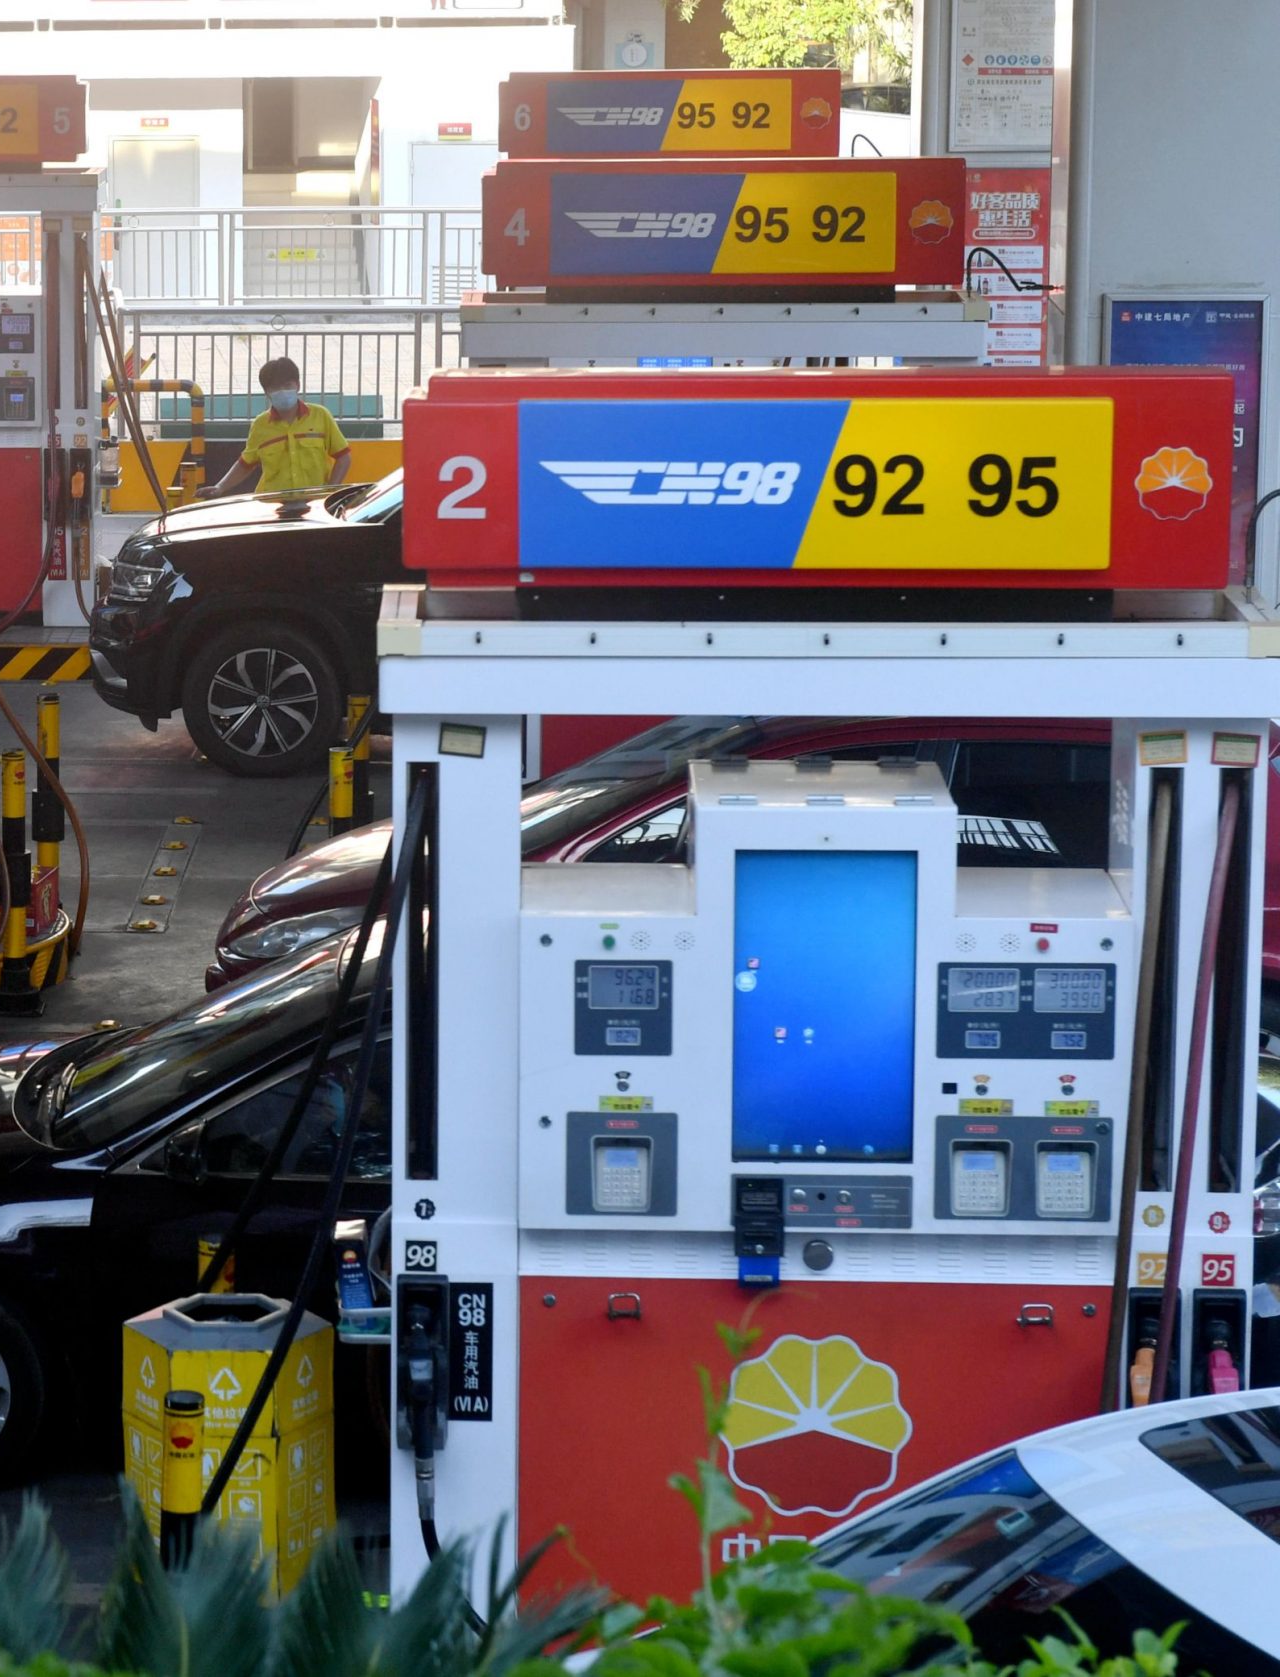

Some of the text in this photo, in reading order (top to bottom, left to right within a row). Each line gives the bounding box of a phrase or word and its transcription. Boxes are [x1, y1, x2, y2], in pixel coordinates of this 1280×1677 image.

[52, 107, 71, 134] 5
[513, 103, 531, 132] 6
[575, 102, 771, 130] CN98 95 92
[971, 192, 1041, 210] 好客品质
[503, 208, 531, 246] 4
[590, 206, 867, 245] CN98 95 92
[1135, 313, 1191, 321] 中建七局地产
[74, 435, 88, 447] 92
[437, 455, 487, 520] 2
[580, 454, 1060, 518] CN98 92 95
[407, 1245, 437, 1265] 98
[1140, 1257, 1167, 1279] 92
[1203, 1259, 1232, 1280] 95
[458, 1294, 486, 1308] CN
[459, 1309, 486, 1327] 98
[463, 1331, 480, 1389] 车用汽油
